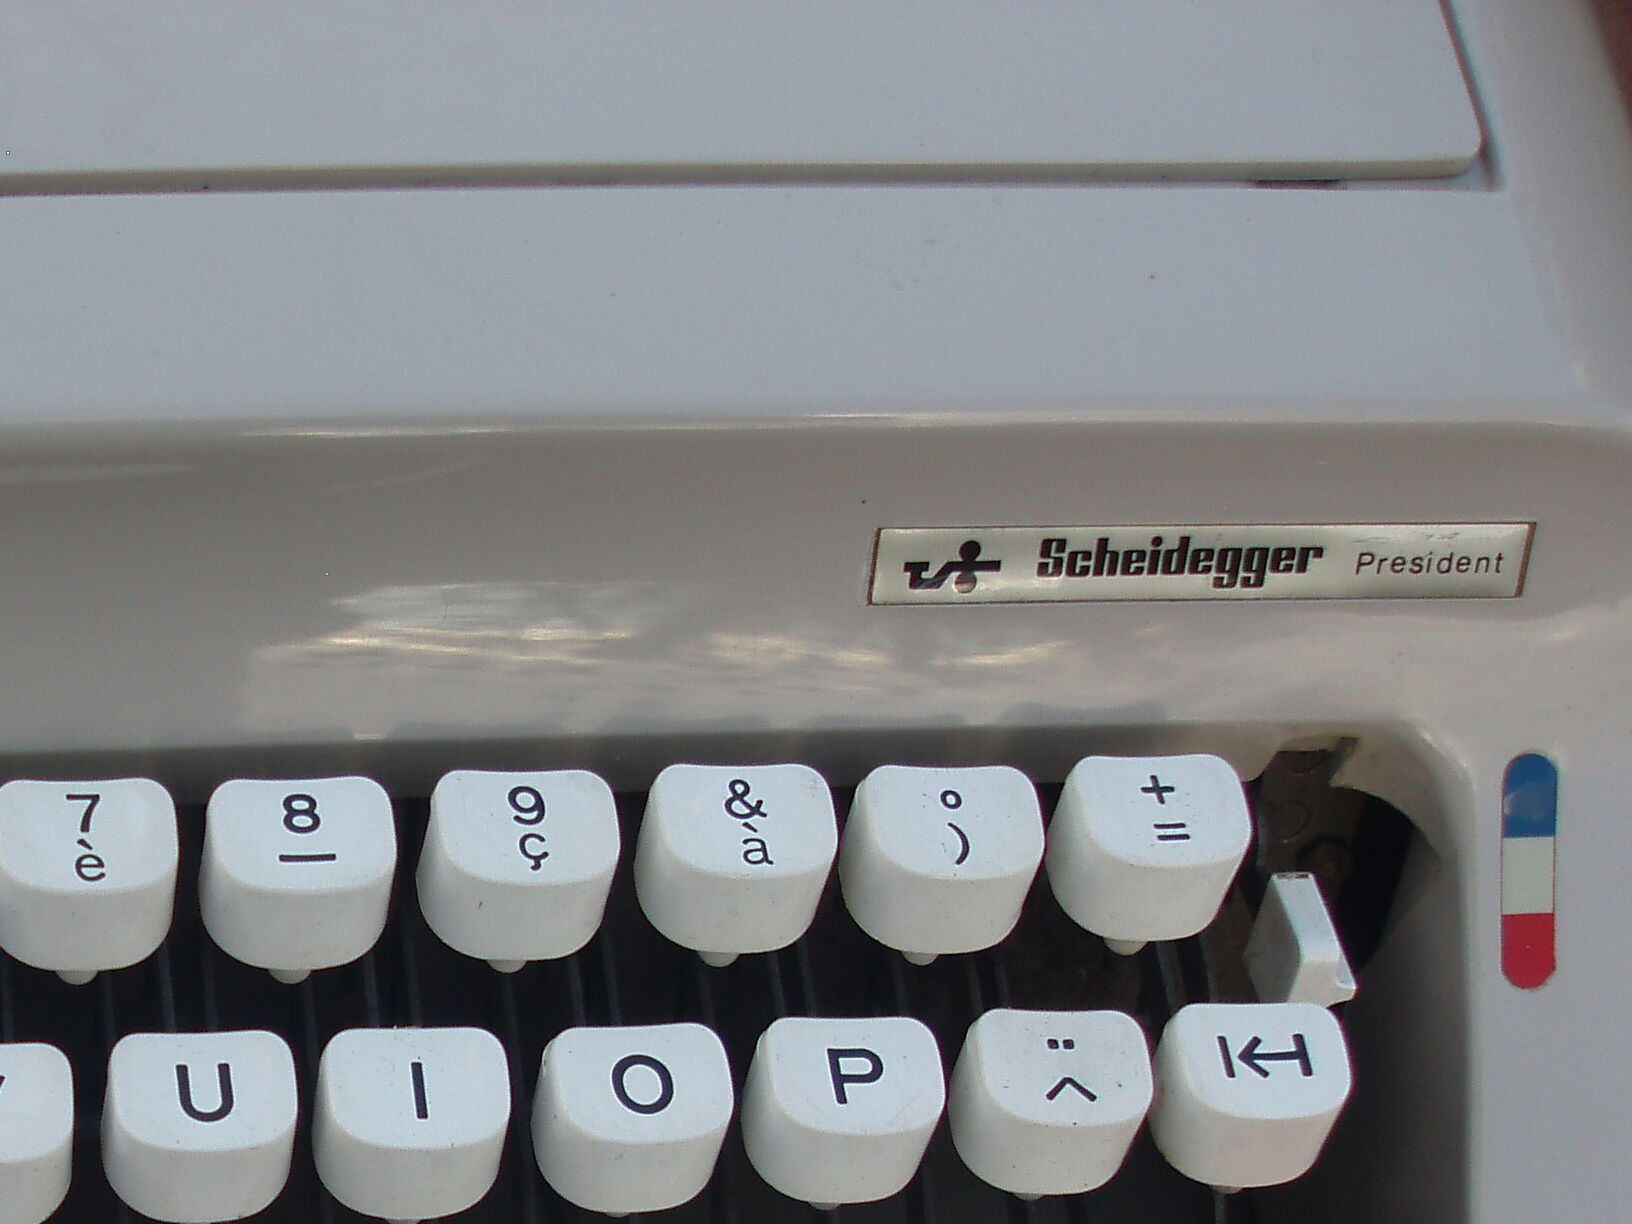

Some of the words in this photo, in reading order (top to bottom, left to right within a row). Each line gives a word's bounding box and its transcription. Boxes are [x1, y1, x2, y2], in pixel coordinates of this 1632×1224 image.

[1036, 536, 1325, 589] Scheidegger
[1355, 550, 1505, 575] President
[507, 785, 546, 826] 9
[724, 779, 768, 820] &
[1140, 774, 1176, 805] +
[65, 793, 100, 833] 7
[282, 793, 321, 834] 8
[1153, 822, 1191, 841] =
[75, 838, 106, 882] è
[519, 832, 549, 871] ç
[742, 821, 774, 865] à
[947, 822, 970, 865] )
[175, 1062, 234, 1123] U
[410, 1061, 429, 1120] I
[611, 1054, 674, 1115] O
[826, 1048, 884, 1105] P
